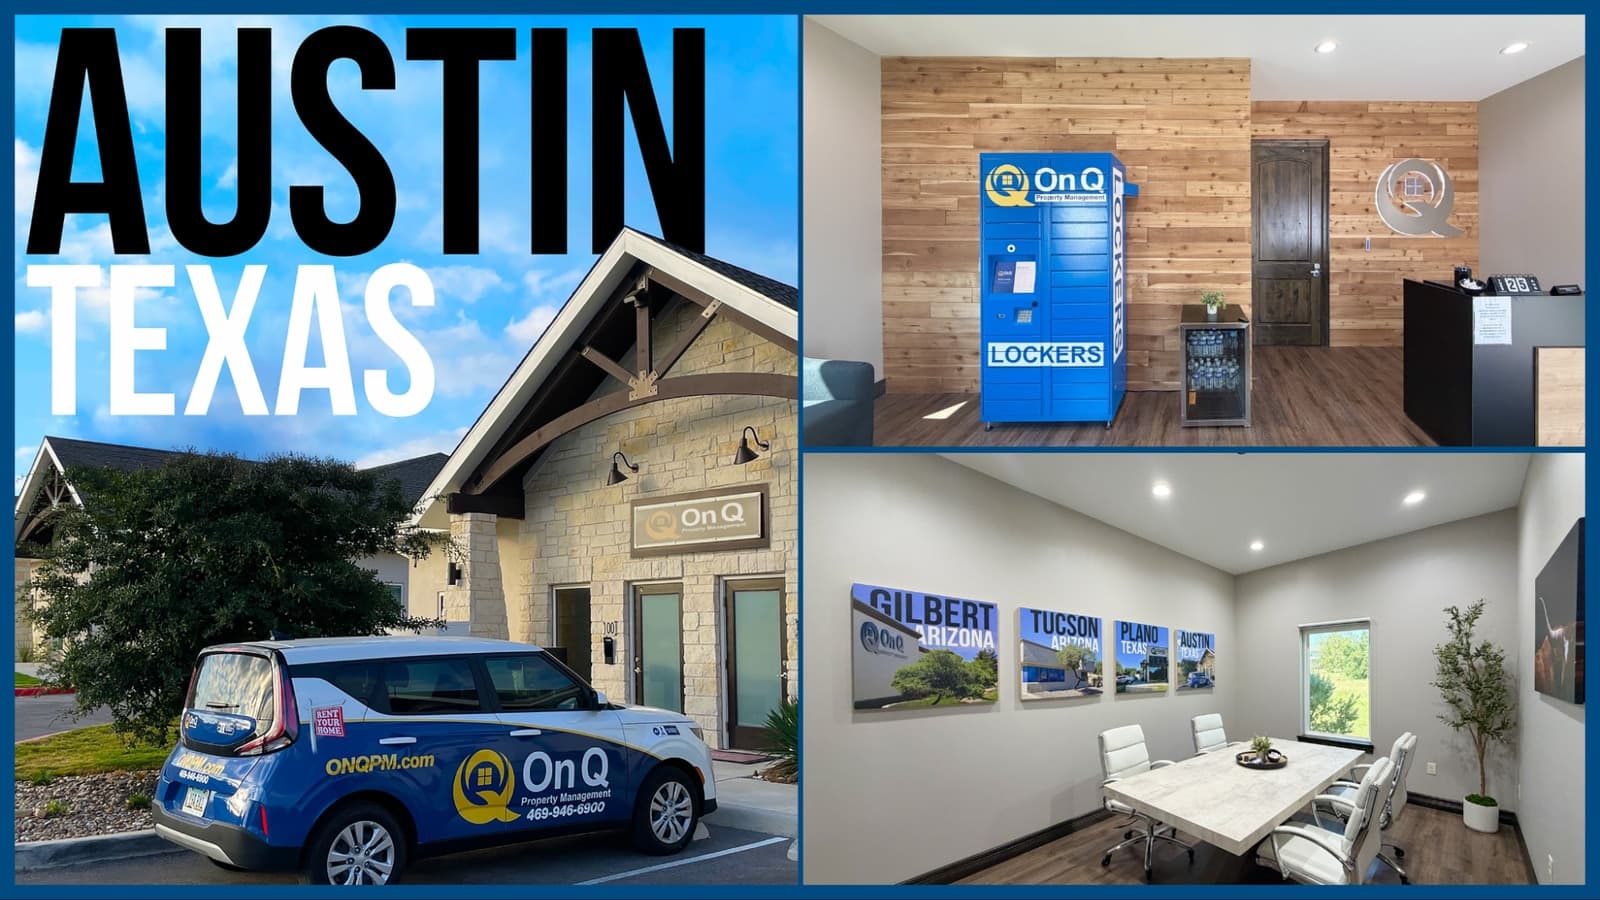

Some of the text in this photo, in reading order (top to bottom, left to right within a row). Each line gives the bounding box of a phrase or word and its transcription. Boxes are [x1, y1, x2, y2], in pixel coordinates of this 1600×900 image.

[1035, 167, 1104, 193] On Q
[1114, 174, 1123, 354] LOCKERS
[991, 346, 1101, 363] LOCKERS
[681, 502, 744, 527] On Q
[870, 589, 994, 630] GILBERT
[1030, 609, 1098, 638] TUCSON
[1121, 621, 1158, 643] PLANO
[915, 624, 994, 648] ARIZONA
[1181, 632, 1210, 649] AUSTIN
[1121, 640, 1147, 655] TEXAS
[1181, 647, 1200, 658] TEXAS
[317, 710, 339, 719] RENT
[317, 718, 340, 726] YOUR
[317, 726, 342, 735] HOME
[326, 753, 435, 776] ONQPM.com
[523, 747, 609, 793] On Q
[521, 788, 611, 807] Property Management
[526, 801, 605, 821] 469-946-6900
